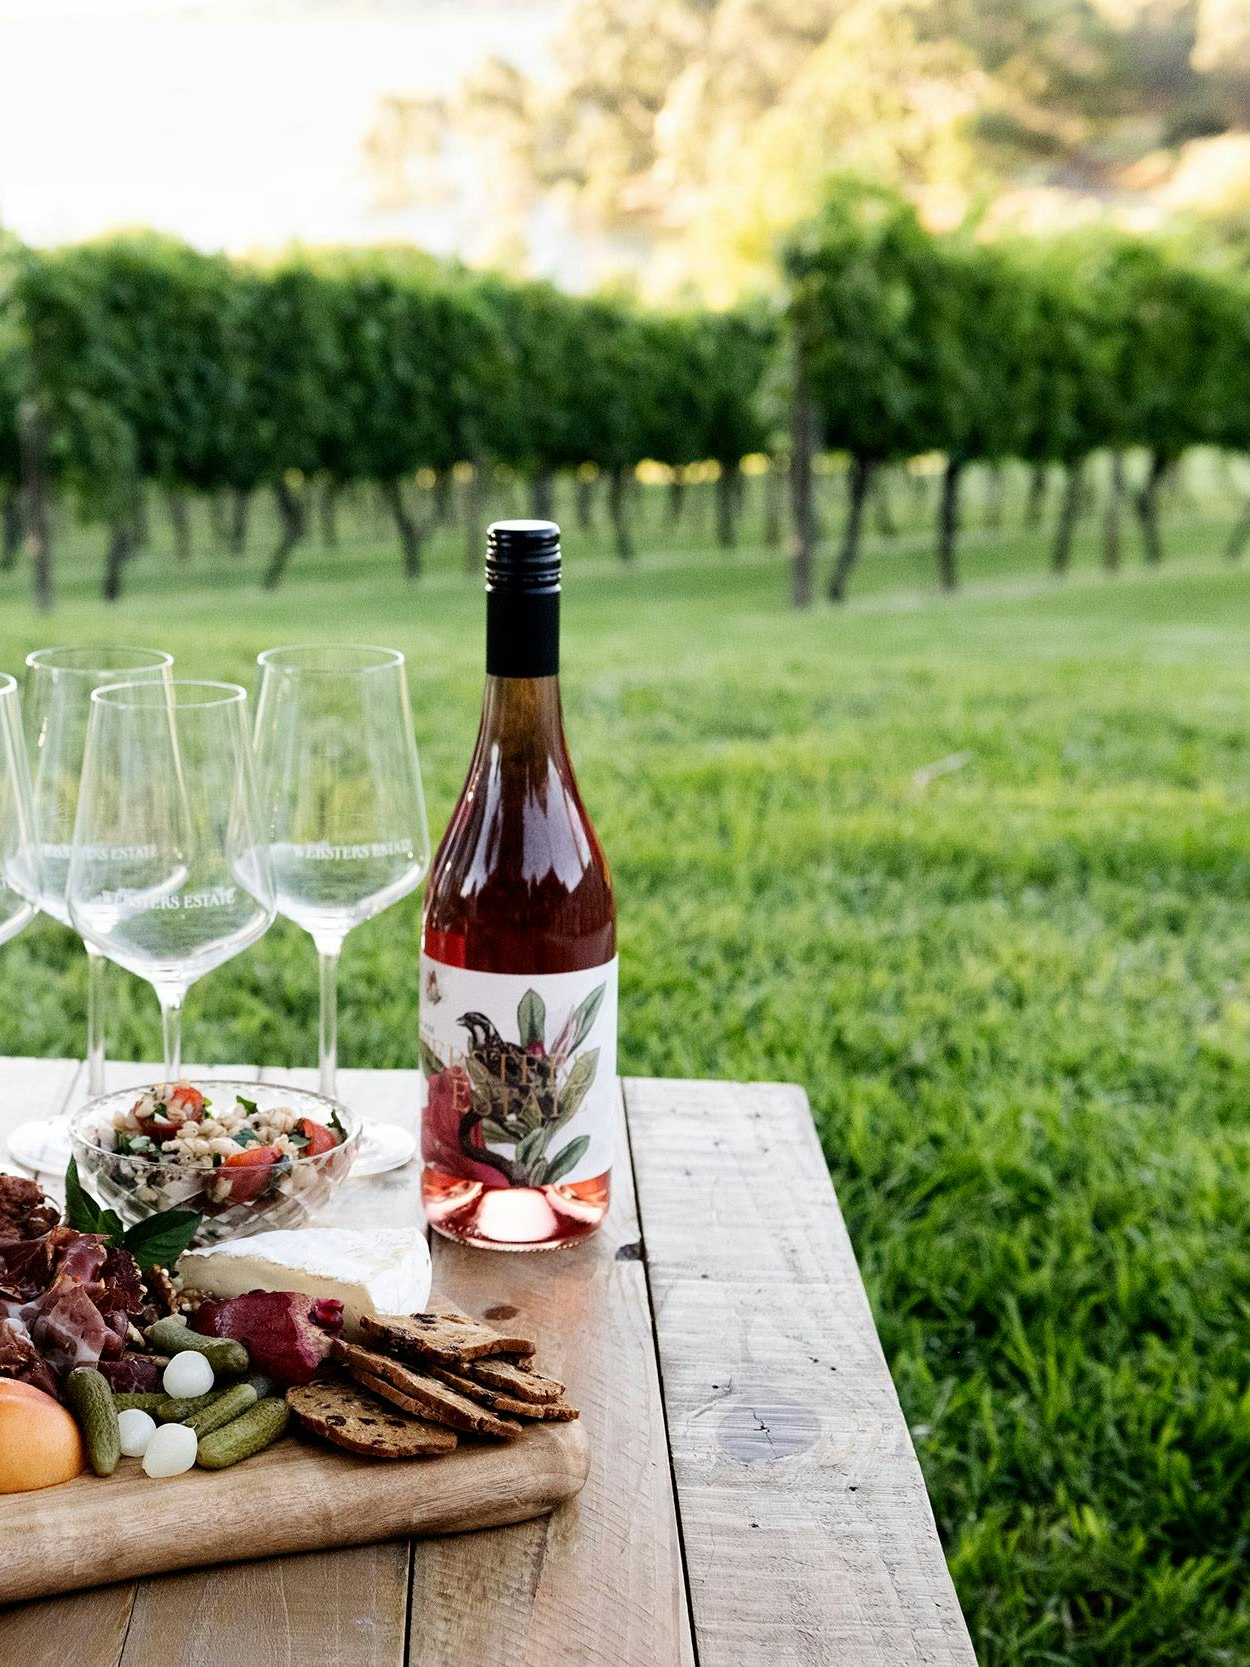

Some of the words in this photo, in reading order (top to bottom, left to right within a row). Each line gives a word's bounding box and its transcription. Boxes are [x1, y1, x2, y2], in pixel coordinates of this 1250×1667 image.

[183, 887, 236, 909] ESTATE
[419, 1034, 588, 1088] EBSTERS
[451, 1079, 588, 1118] ESTAT
